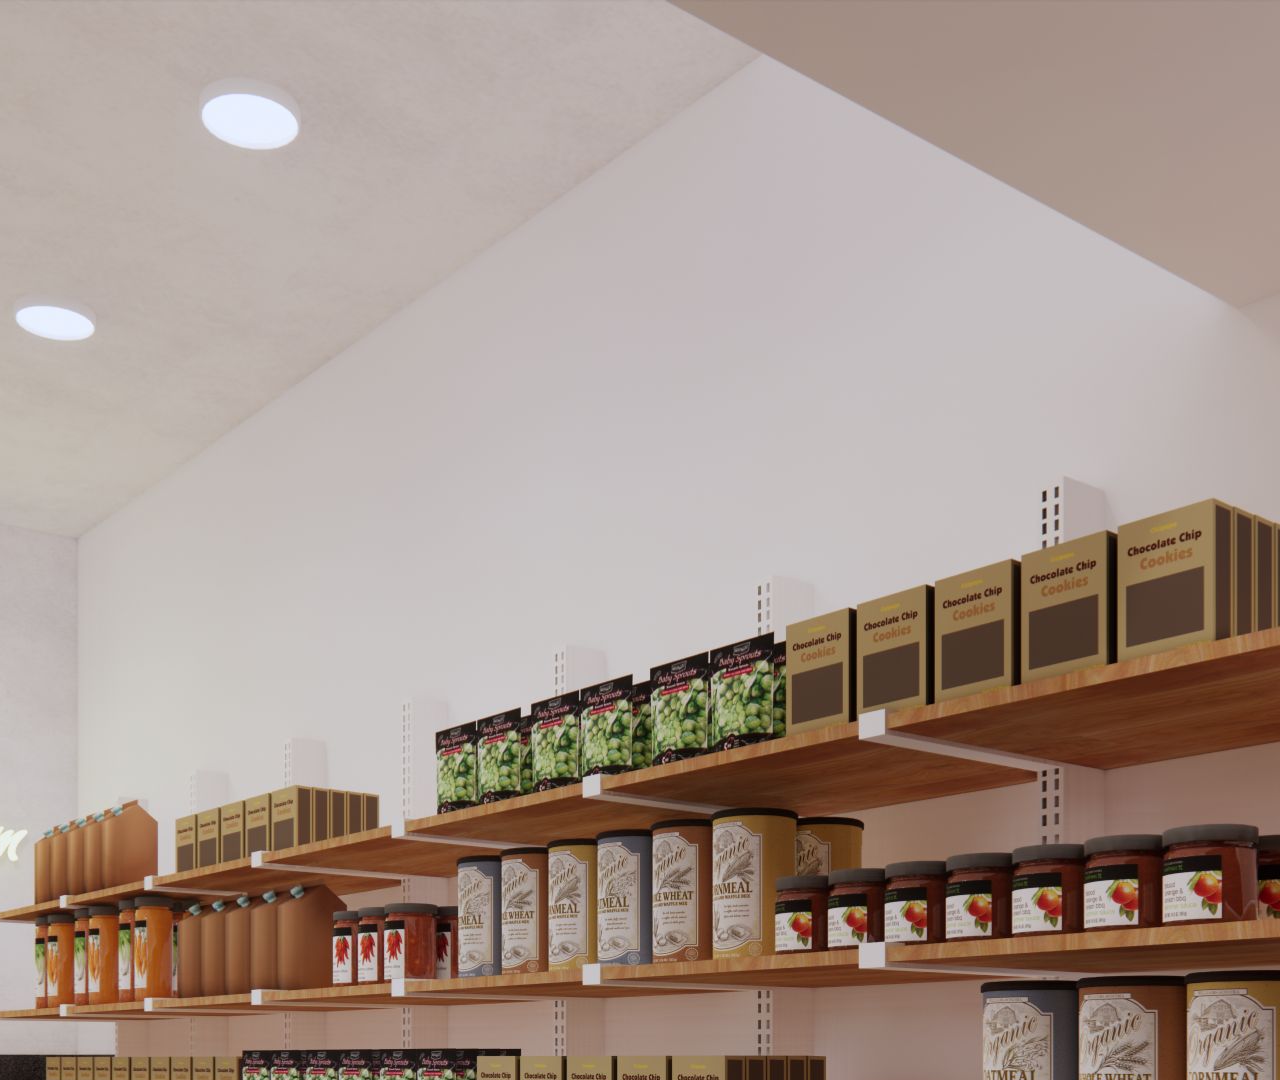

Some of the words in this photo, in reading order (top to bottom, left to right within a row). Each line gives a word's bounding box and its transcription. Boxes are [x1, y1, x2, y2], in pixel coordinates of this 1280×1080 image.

[1127, 536, 1176, 557] Chocolate
[1179, 529, 1202, 543] Chip
[1140, 547, 1193, 570] Cookies
[1030, 566, 1074, 585] Chocolate
[1076, 559, 1097, 571] Chip
[1040, 576, 1089, 597] Cookies
[942, 592, 982, 609] Chocolate
[983, 586, 1003, 597] Chip
[864, 616, 899, 632] Chocolate
[901, 610, 918, 621] Chip
[952, 601, 996, 621] Cookies
[792, 637, 825, 651] Chocolate
[826, 631, 842, 642] Chip
[873, 625, 912, 643] Cookies
[800, 646, 836, 663] Cookies
[662, 891, 694, 900] WHEAT
[508, 911, 535, 919] WHEAT
[501, 1072, 511, 1080] Chip
[524, 1072, 546, 1080] Chocolate
[546, 1072, 557, 1080] Chip
[571, 1072, 595, 1080] Chocolate
